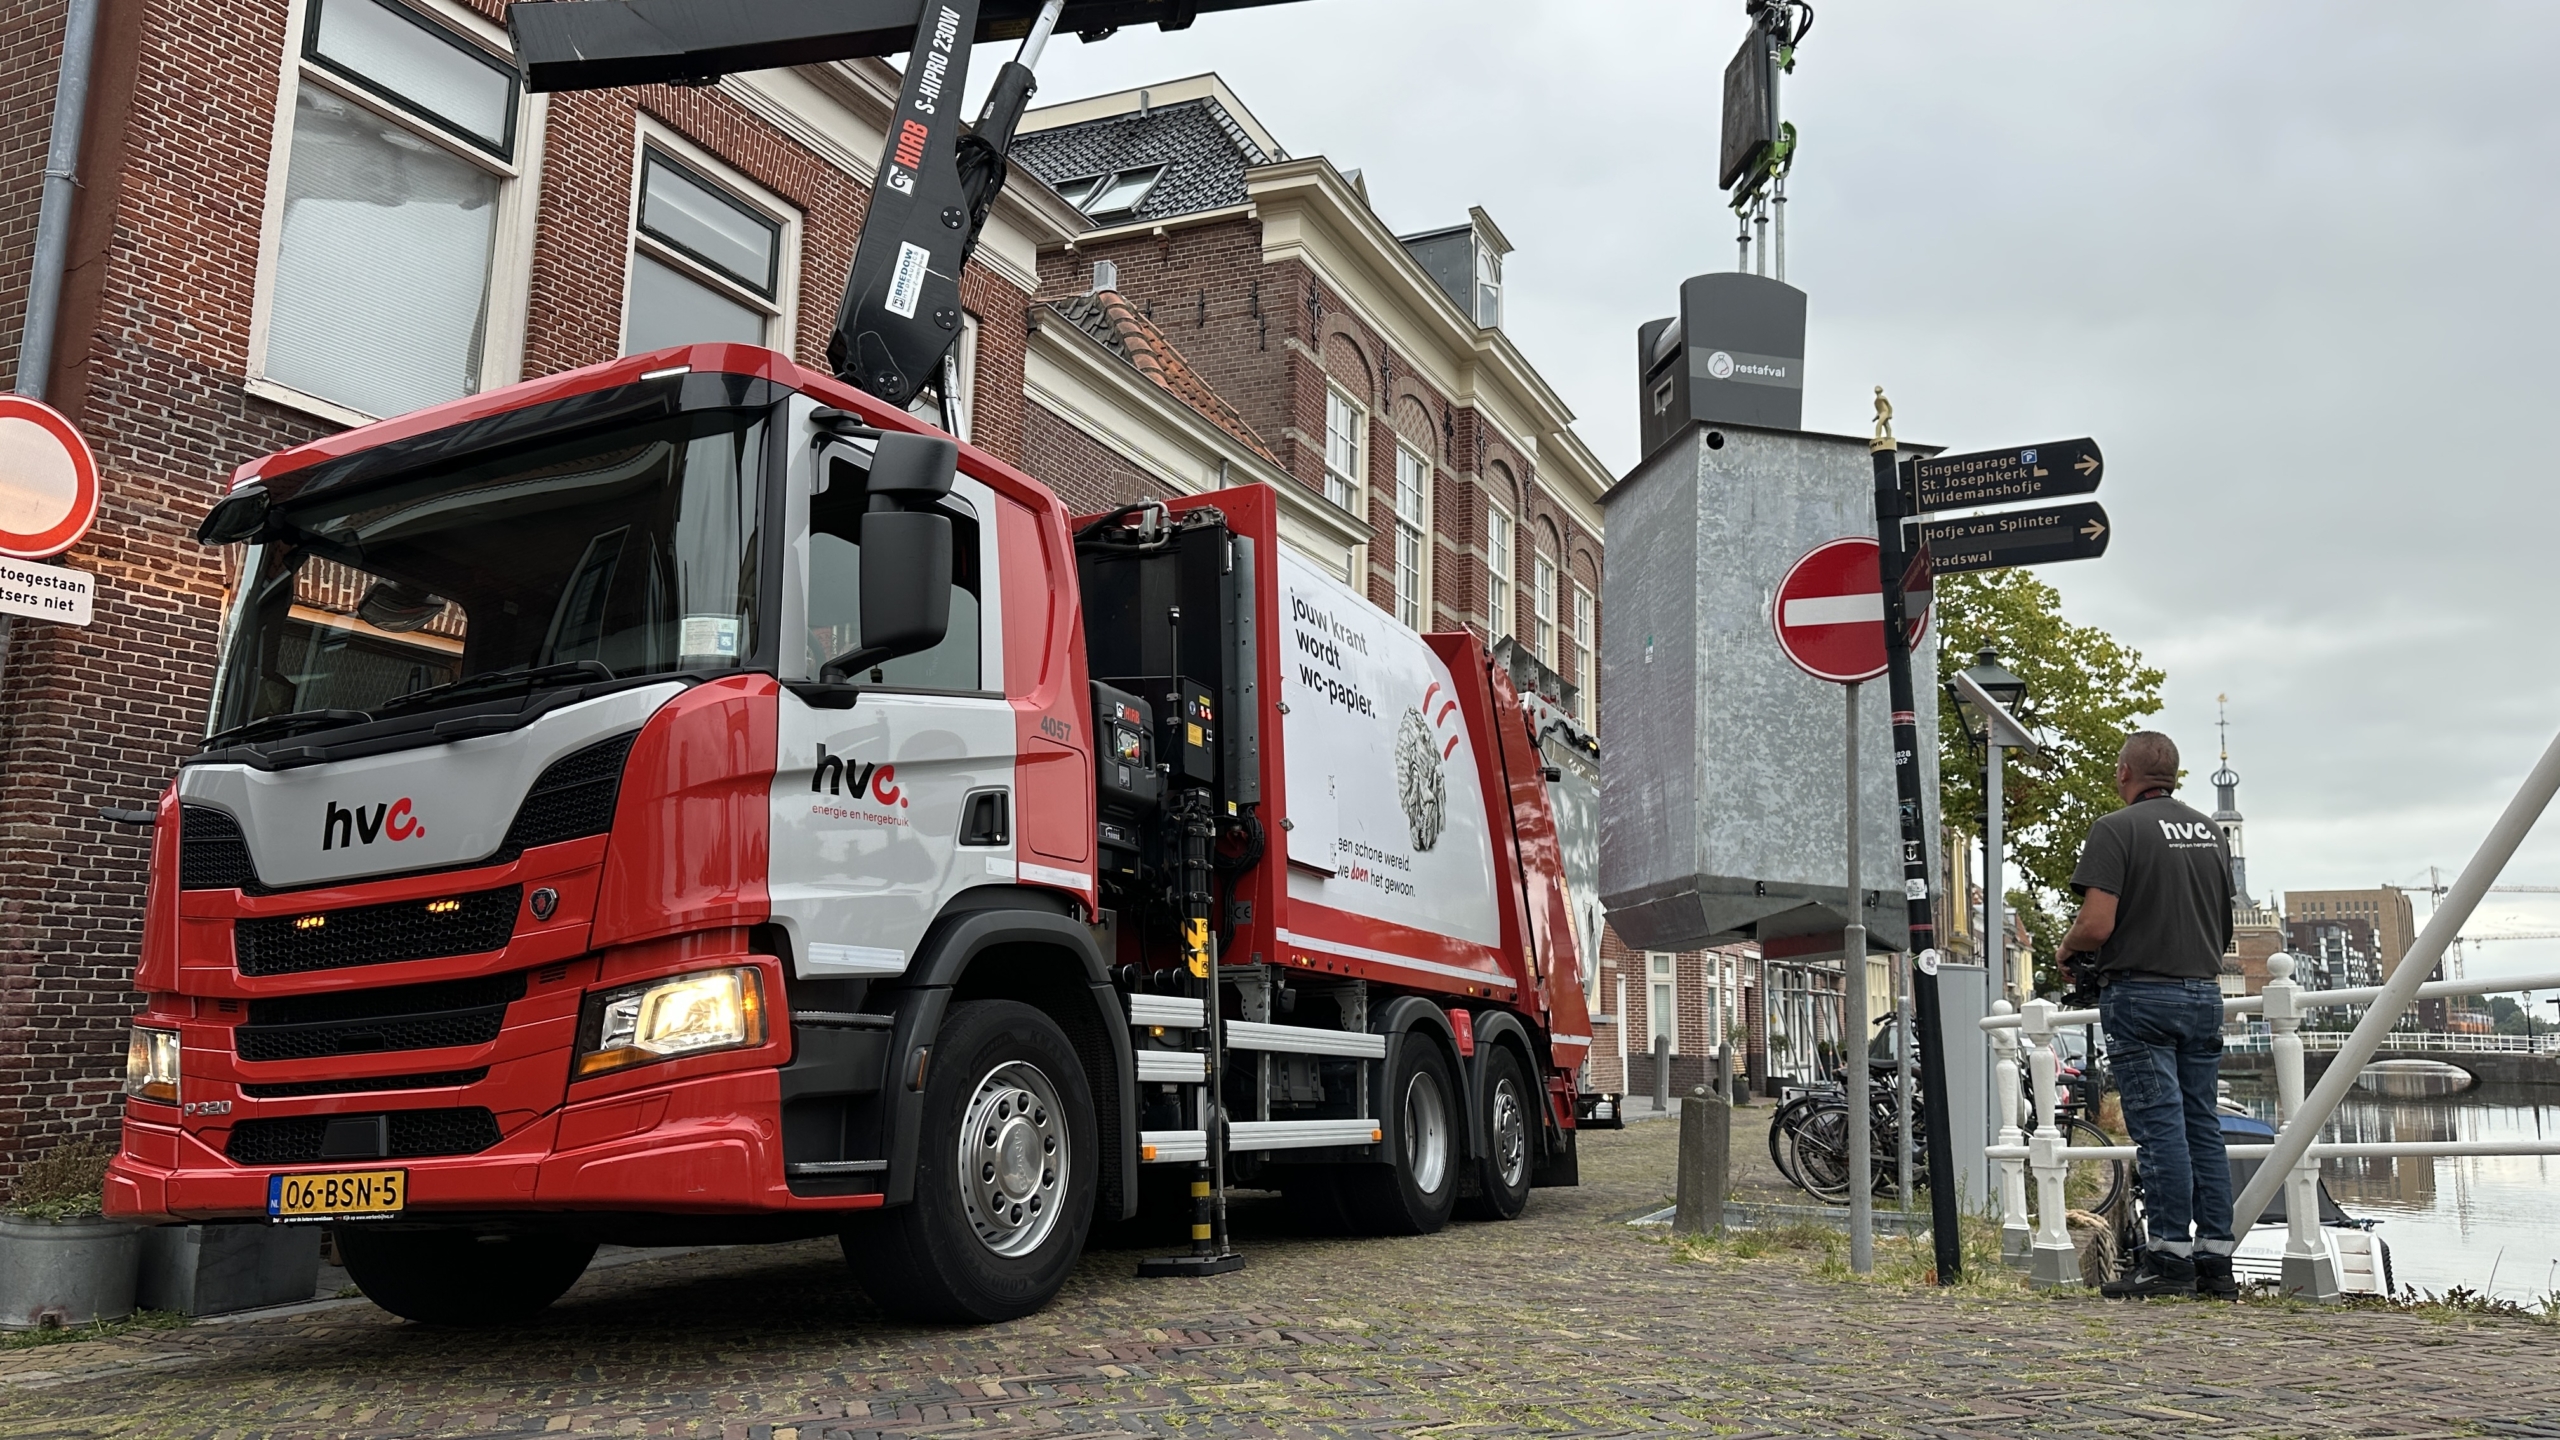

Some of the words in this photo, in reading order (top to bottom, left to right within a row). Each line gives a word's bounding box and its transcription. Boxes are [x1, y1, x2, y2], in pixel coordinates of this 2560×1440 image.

[915, 51, 949, 115] S-HIPRO
[932, 5, 961, 53] 230W
[894, 119, 928, 170] HIAB
[895, 248, 913, 296] BREDOW
[1735, 363, 1786, 378] restafval
[1921, 455, 2017, 477] Singelgarage
[1922, 480, 1940, 491] St.
[1944, 468, 2028, 488] Josephkerk
[1922, 480, 2042, 505] Wildemanshofje
[1925, 524, 1965, 540] Hofje
[1969, 523, 1994, 535] van
[1999, 514, 2061, 531] Splinter
[0, 566, 86, 594] toegestaan
[44, 596, 75, 612] niet
[1290, 587, 1327, 632] jouw
[1329, 611, 1369, 656] krant
[1295, 629, 1341, 671] wordt
[1299, 663, 1376, 720] wc-papier.
[1040, 715, 1072, 742] 4057
[1124, 706, 1141, 725] HIAB
[811, 742, 909, 809] hvc.
[322, 797, 426, 851] hvc.
[812, 804, 847, 819] energie
[849, 809, 861, 819] en
[863, 811, 909, 827] hergebruik
[2158, 819, 2217, 841] hvc.
[1355, 841, 1383, 864] schone
[1385, 852, 1412, 873] wereld.
[1350, 860, 1369, 882] doen
[1370, 869, 1383, 889] het
[1385, 879, 1416, 898] gewoon.
[183, 1102, 196, 1117] P
[197, 1100, 232, 1116] 320
[271, 1199, 280, 1209] NL
[286, 1176, 398, 1209] 06-BSN-5
